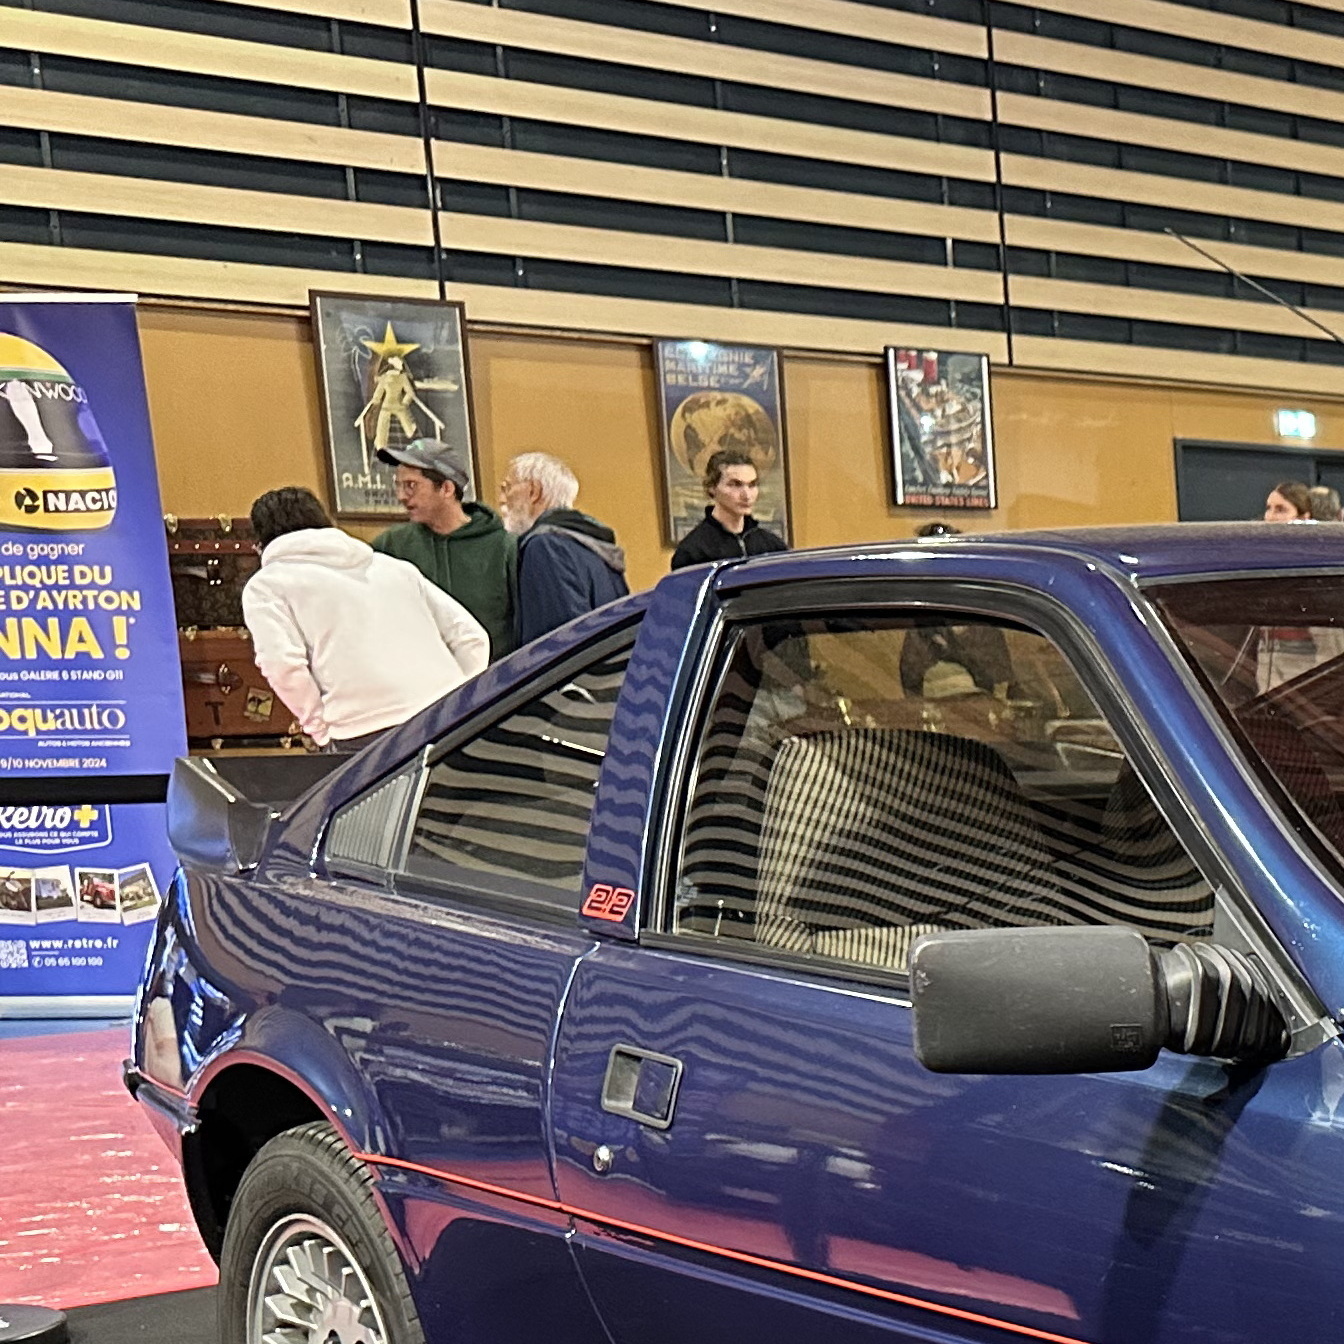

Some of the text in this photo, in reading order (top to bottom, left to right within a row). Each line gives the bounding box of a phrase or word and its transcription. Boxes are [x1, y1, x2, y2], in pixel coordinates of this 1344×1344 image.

[1, 541, 85, 560] de gagner
[74, 564, 112, 586] DU
[10, 589, 141, 611] D'AYRTON
[205, 701, 224, 725] T
[25, 758, 80, 768] NOVEMBRE
[82, 758, 107, 768] 2024
